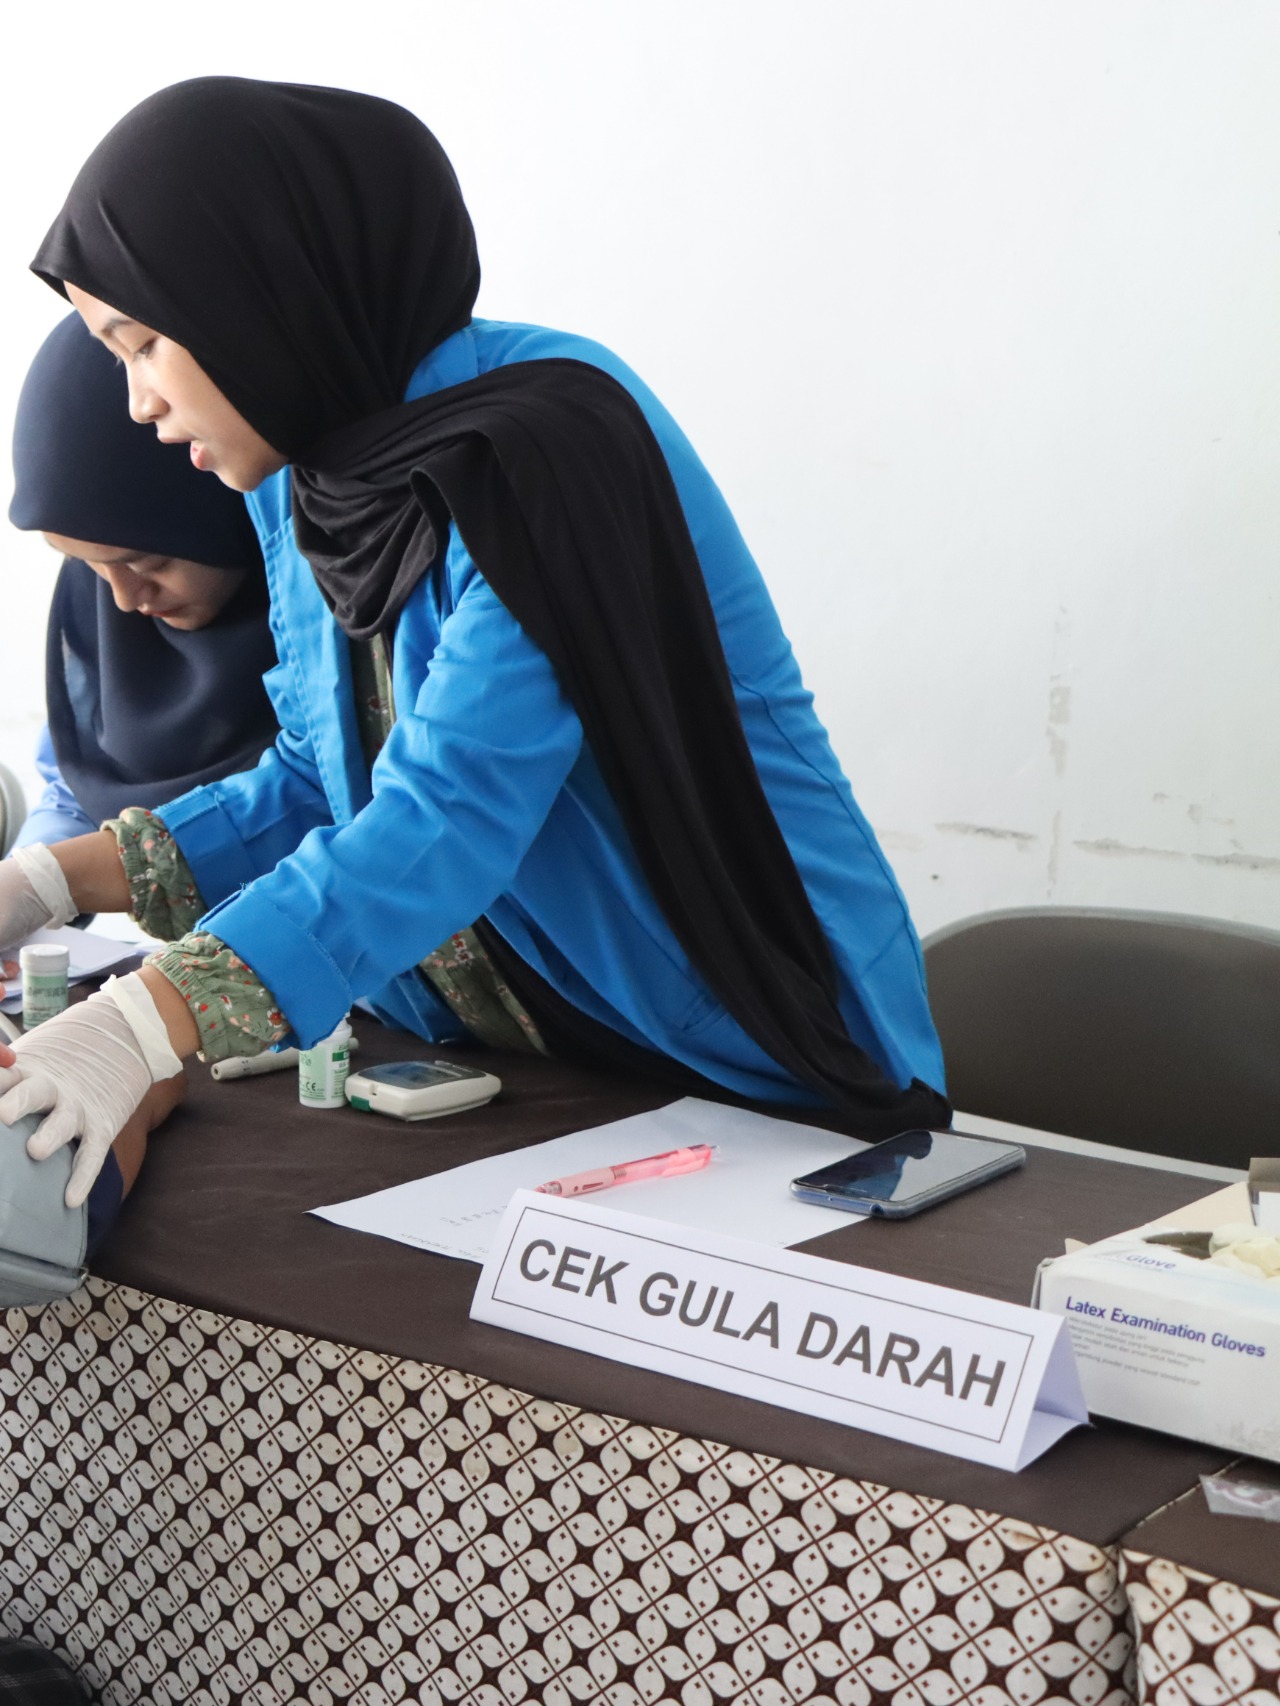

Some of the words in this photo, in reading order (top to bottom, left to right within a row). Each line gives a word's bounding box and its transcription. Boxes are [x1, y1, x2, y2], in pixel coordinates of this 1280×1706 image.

[519, 1239, 629, 1304] CEK
[638, 1272, 780, 1349] GULA
[796, 1312, 1006, 1407] DARAH
[1065, 1296, 1107, 1319] Latex
[1110, 1308, 1206, 1344] Examination
[1210, 1332, 1266, 1358] Gloves
